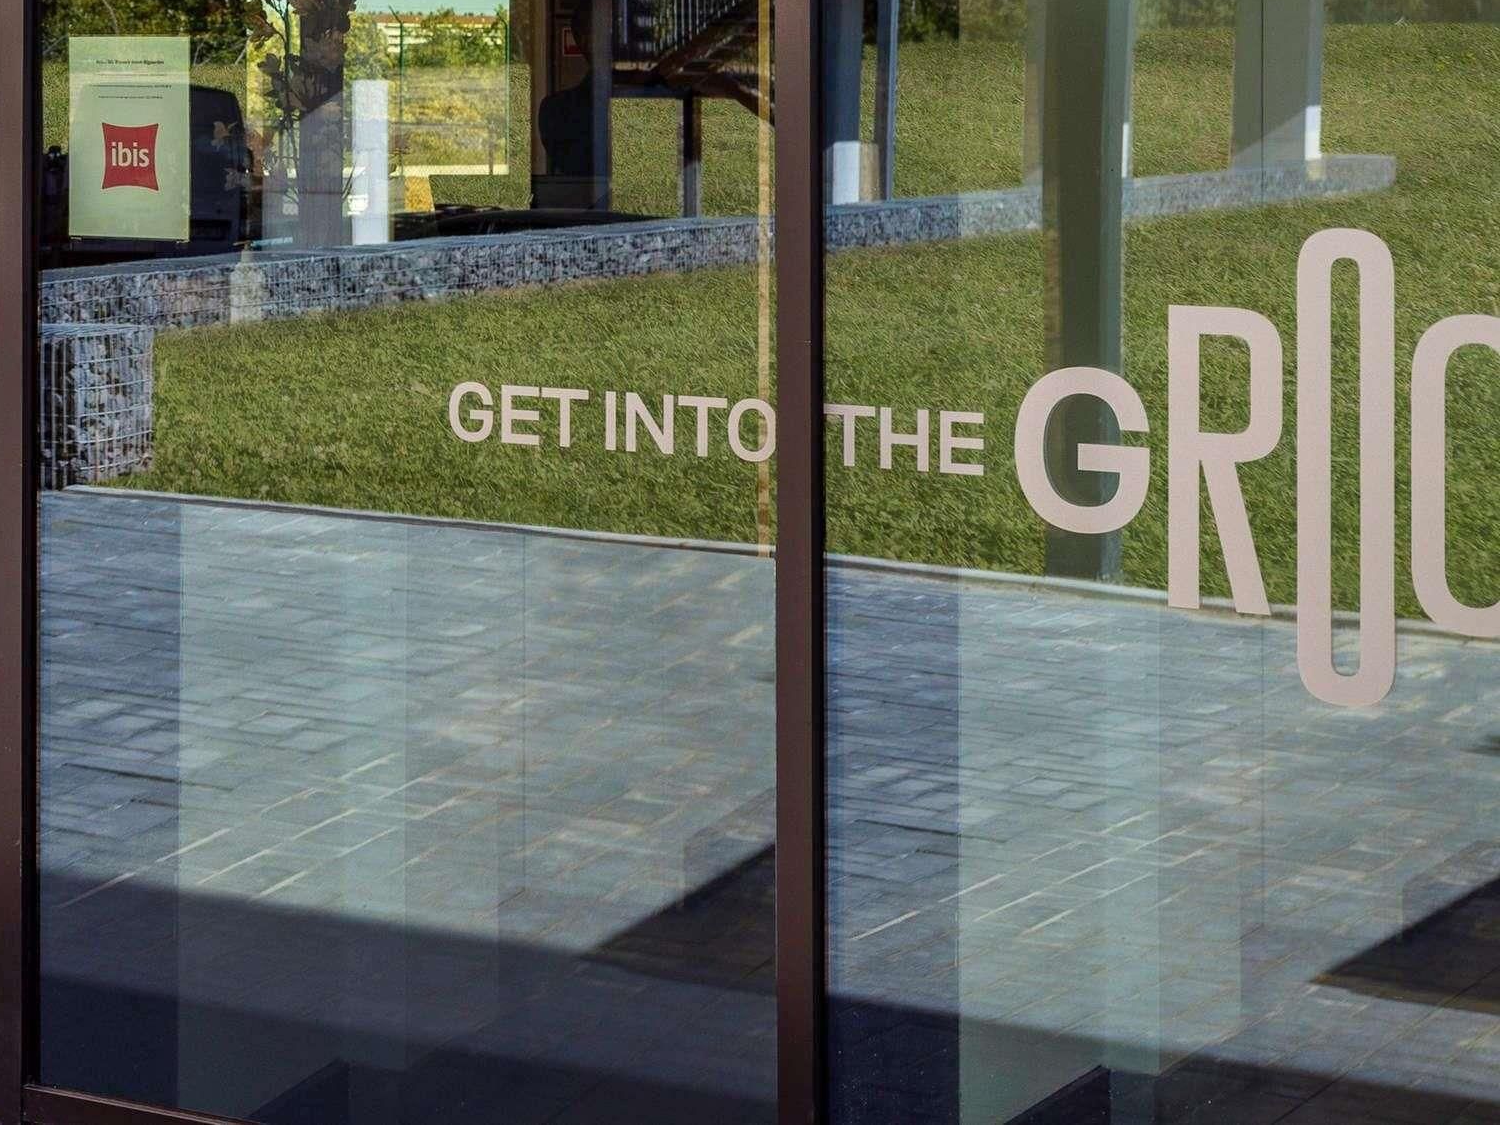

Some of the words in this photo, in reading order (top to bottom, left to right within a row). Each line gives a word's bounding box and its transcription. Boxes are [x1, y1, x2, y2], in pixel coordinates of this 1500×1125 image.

[111, 141, 151, 168] ibis
[448, 380, 590, 449] GET
[604, 390, 777, 463] INTO
[822, 402, 985, 477] THE
